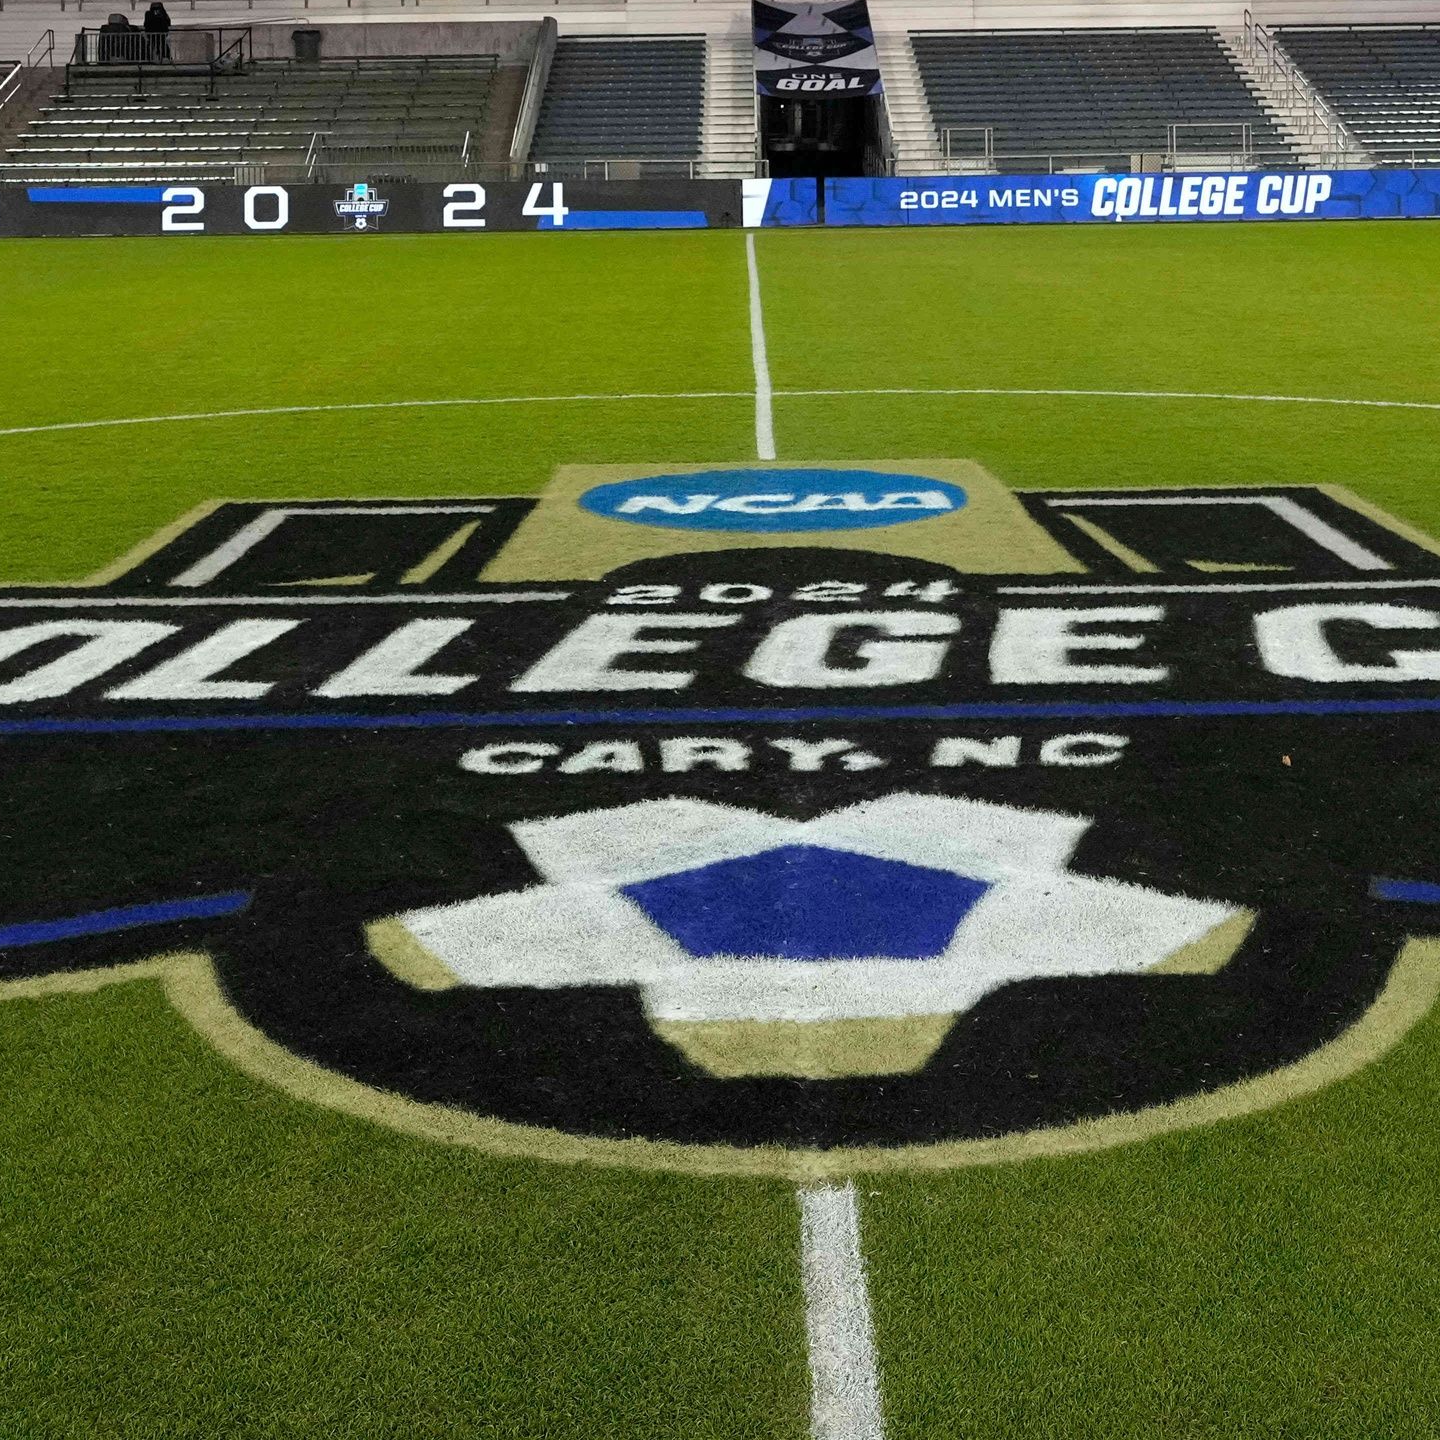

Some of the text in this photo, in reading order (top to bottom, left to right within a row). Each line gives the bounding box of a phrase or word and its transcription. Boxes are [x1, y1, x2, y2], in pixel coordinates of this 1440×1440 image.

[776, 77, 865, 91] GOAL
[900, 190, 978, 210] 2024
[1091, 176, 1248, 216] COLLEGE
[1256, 175, 1333, 215] CUP
[617, 490, 955, 515] NCAA
[606, 580, 960, 605] 2024
[459, 732, 1131, 775] CARY, NC
